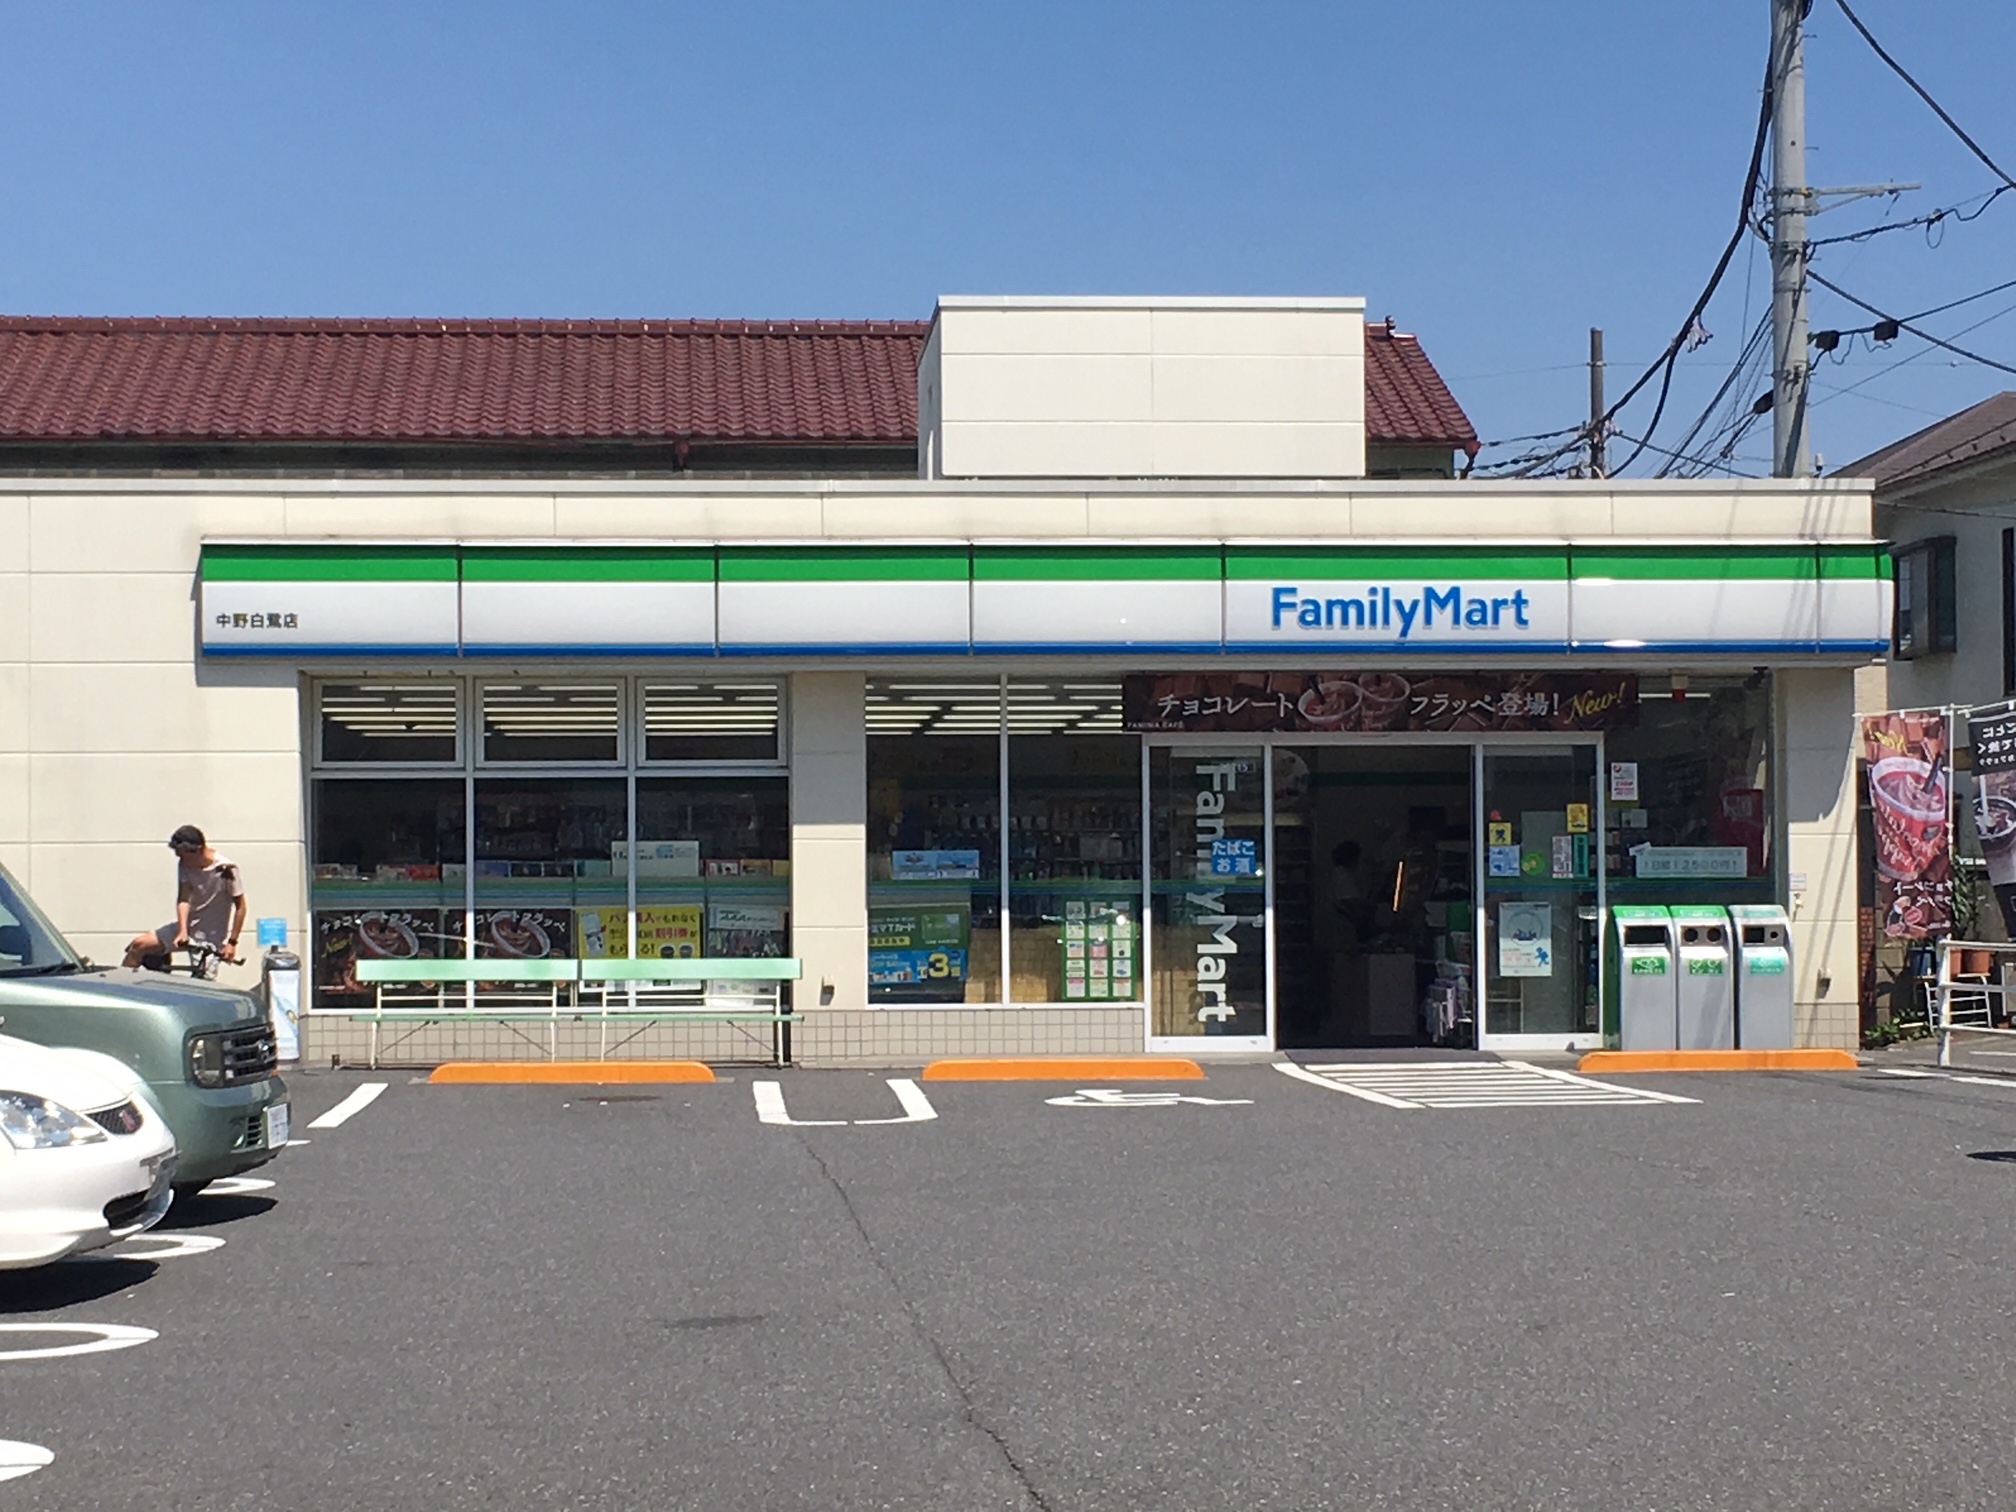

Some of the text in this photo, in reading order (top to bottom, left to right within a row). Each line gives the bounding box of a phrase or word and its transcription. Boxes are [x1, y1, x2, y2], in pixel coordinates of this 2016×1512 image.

[1271, 586, 1529, 639] FamilyMart
[1157, 693, 1293, 717] チョコレート
[1563, 682, 1626, 725] New!
[1212, 841, 1255, 856] たばこ
[1216, 857, 1251, 873] お酒
